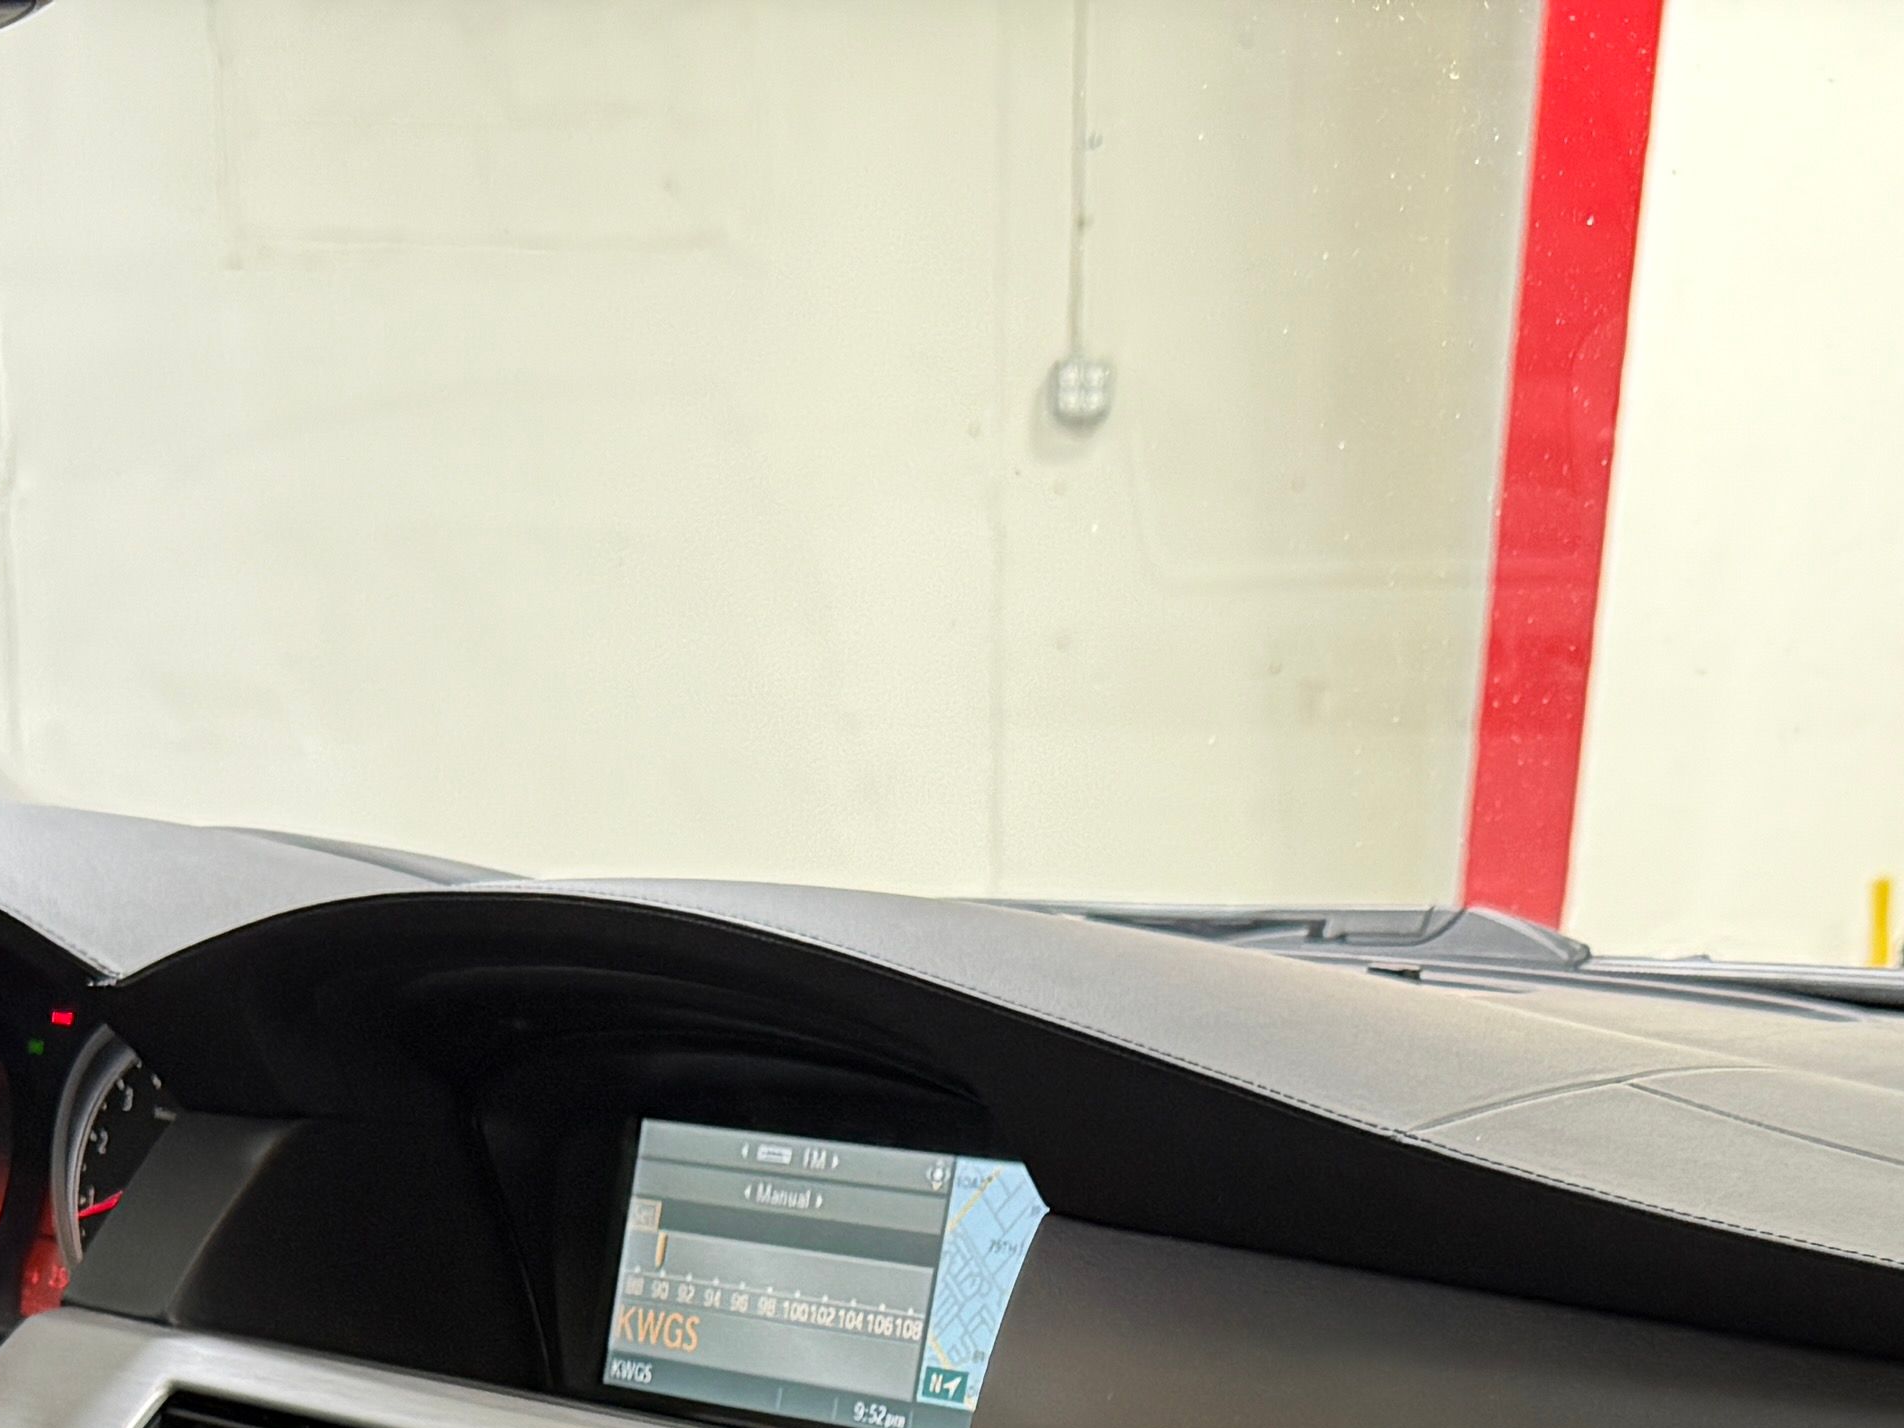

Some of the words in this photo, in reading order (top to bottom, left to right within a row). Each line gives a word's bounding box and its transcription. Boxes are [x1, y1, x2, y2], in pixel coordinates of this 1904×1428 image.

[755, 1182, 811, 1209] Manual
[703, 1287, 722, 1309] 94
[783, 1300, 809, 1322] 100
[810, 1304, 836, 1327] 102
[839, 1308, 865, 1331] 104
[867, 1313, 894, 1336] 106
[895, 1318, 924, 1341] 108
[614, 1303, 701, 1353] KWGS
[610, 1358, 653, 1383] KWGS
[853, 1401, 906, 1428] 9:52pm
